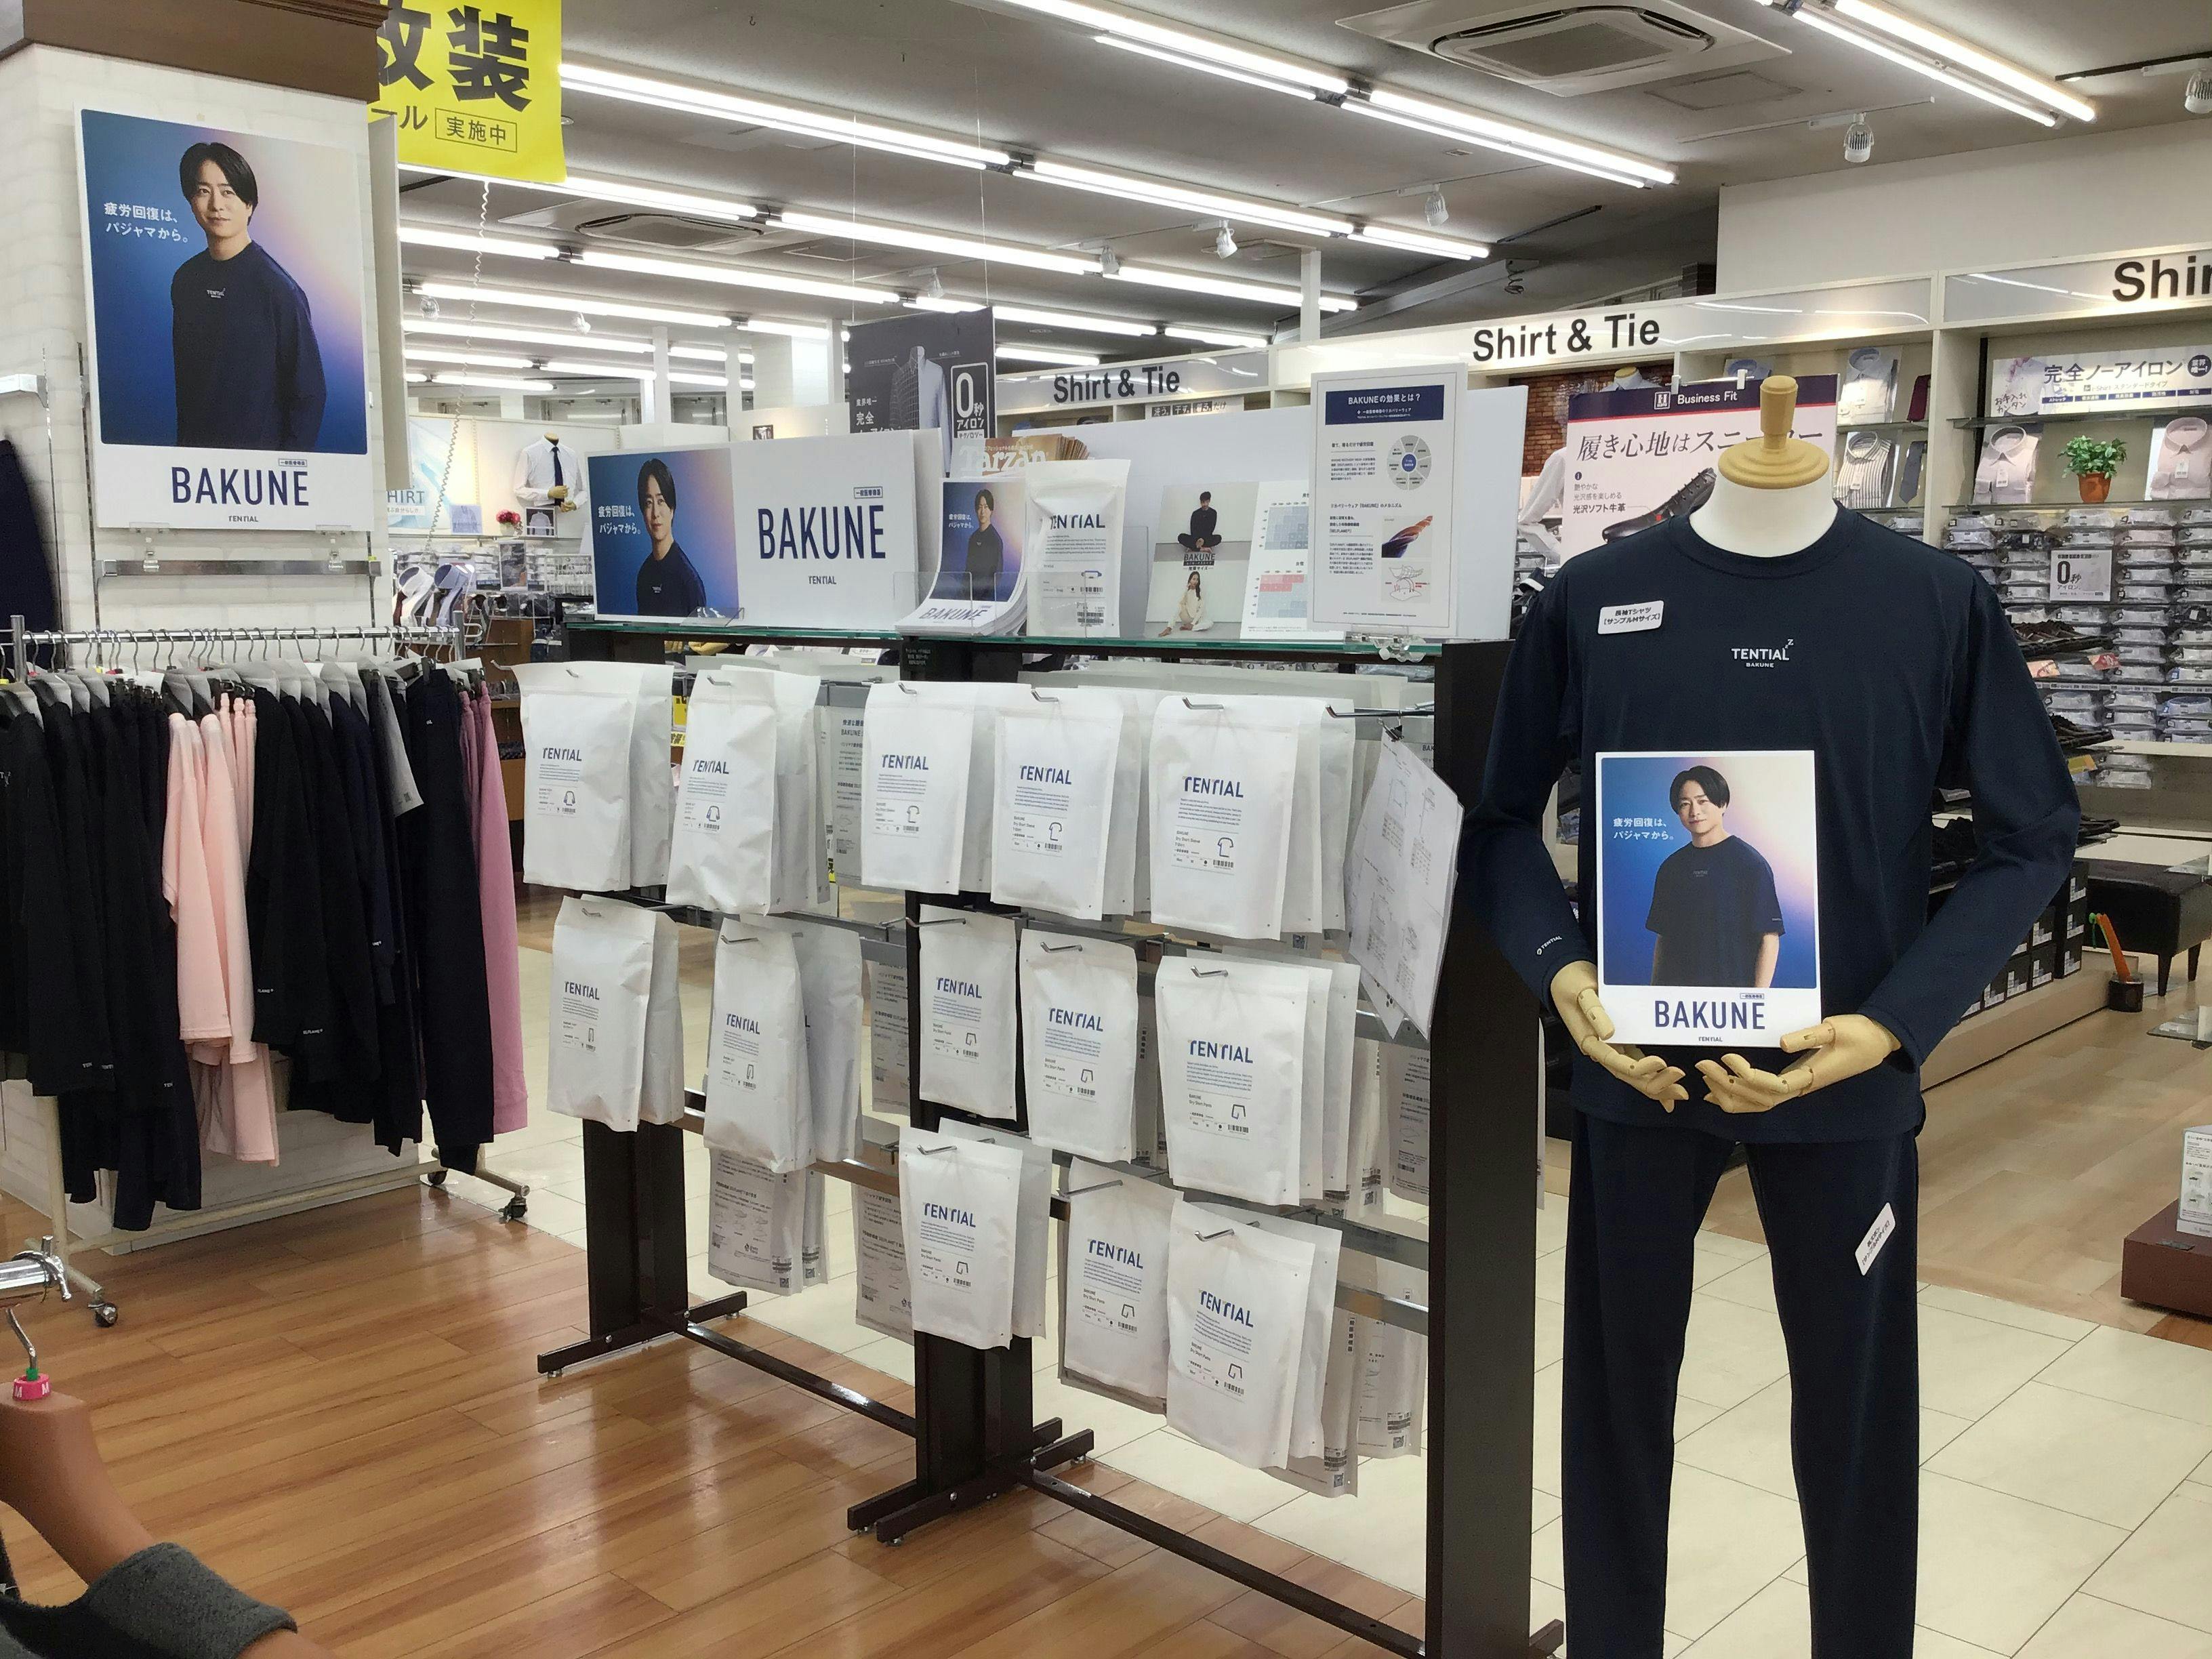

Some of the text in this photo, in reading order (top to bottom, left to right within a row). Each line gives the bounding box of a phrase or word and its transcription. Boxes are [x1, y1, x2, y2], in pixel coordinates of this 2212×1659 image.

[447, 117, 507, 145] 実施中
[104, 203, 178, 222] 疲労回復は、
[106, 222, 188, 243] パジャマから。
[2112, 255, 2212, 302] Shir
[1473, 313, 1660, 361] Shirt & Tie
[2044, 360, 2183, 384] 完全ノーアイロン
[1053, 366, 1180, 403] Shirt & Tie
[1677, 390, 1738, 405] Business Fit
[856, 411, 874, 425] 完全
[957, 417, 985, 430] アイロン
[1577, 431, 1823, 462] 履き心地はスニーー
[959, 445, 1046, 472] Tarzan
[172, 467, 309, 506] BAKUNE
[1574, 492, 1622, 501] 光沢感を楽しめる
[598, 505, 635, 518] 疲労回復は、
[1573, 503, 1626, 514] 光沢ソフト牛革
[599, 522, 641, 535] パジャマから。
[758, 505, 886, 560] BAKUNE
[808, 575, 836, 585] TENTIAL
[919, 608, 987, 621] BAKUNE
[1615, 607, 1652, 616] 長袖Tシャツ
[1731, 648, 1789, 661] TENTIAL
[542, 747, 582, 761] TENTIAL
[882, 754, 929, 771] TENTIAL
[693, 760, 729, 775] TENTIAL
[1020, 765, 1071, 785] TENTIAL
[1183, 776, 1244, 798] TENTIAL
[1614, 817, 1666, 827] 疲労回復は、
[1614, 831, 1673, 840] パジャマから。
[565, 981, 600, 1000] TENTIAL
[936, 977, 982, 999] TENTIAL
[726, 1014, 760, 1035] TENTIAL
[1049, 1008, 1103, 1031] TENTIAL
[1655, 1000, 1765, 1029] BAKUNE
[1187, 1040, 1253, 1063] TENTIAL
[923, 1202, 976, 1228] TENTIAL
[1088, 1239, 1143, 1269] TENTIAL
[1199, 1290, 1254, 1328] TENTIAL
